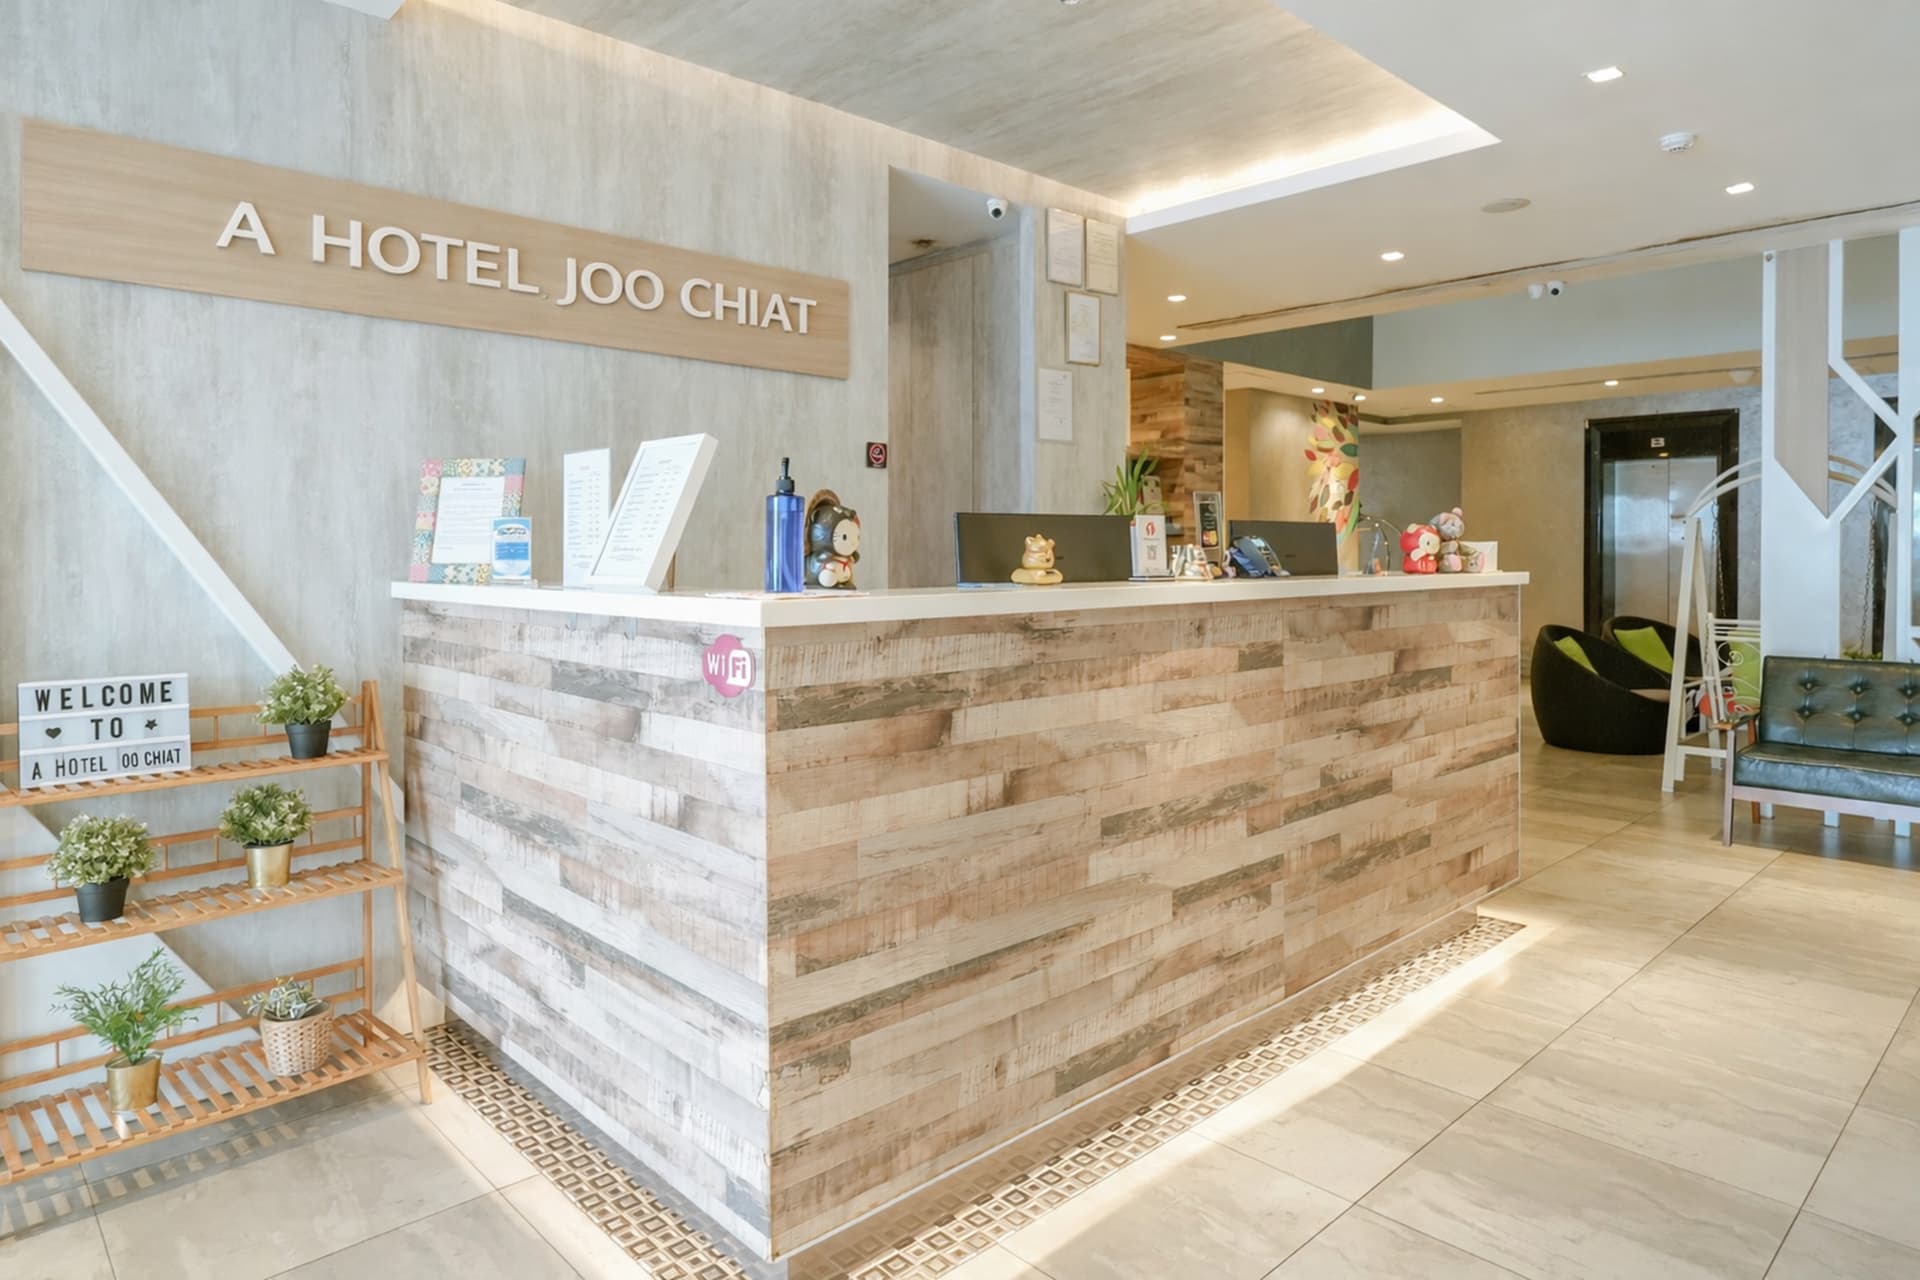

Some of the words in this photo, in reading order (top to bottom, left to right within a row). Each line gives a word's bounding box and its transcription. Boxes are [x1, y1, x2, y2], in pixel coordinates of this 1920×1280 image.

[216, 200, 276, 255] A
[311, 214, 540, 294] HOTEL
[556, 257, 665, 311] JOO
[680, 277, 817, 335] CHIAT
[35, 681, 172, 712] WELCOME
[90, 717, 123, 740] TO
[31, 761, 42, 781] A
[55, 756, 108, 778] HOTEL
[144, 748, 181, 766] CHIAT
